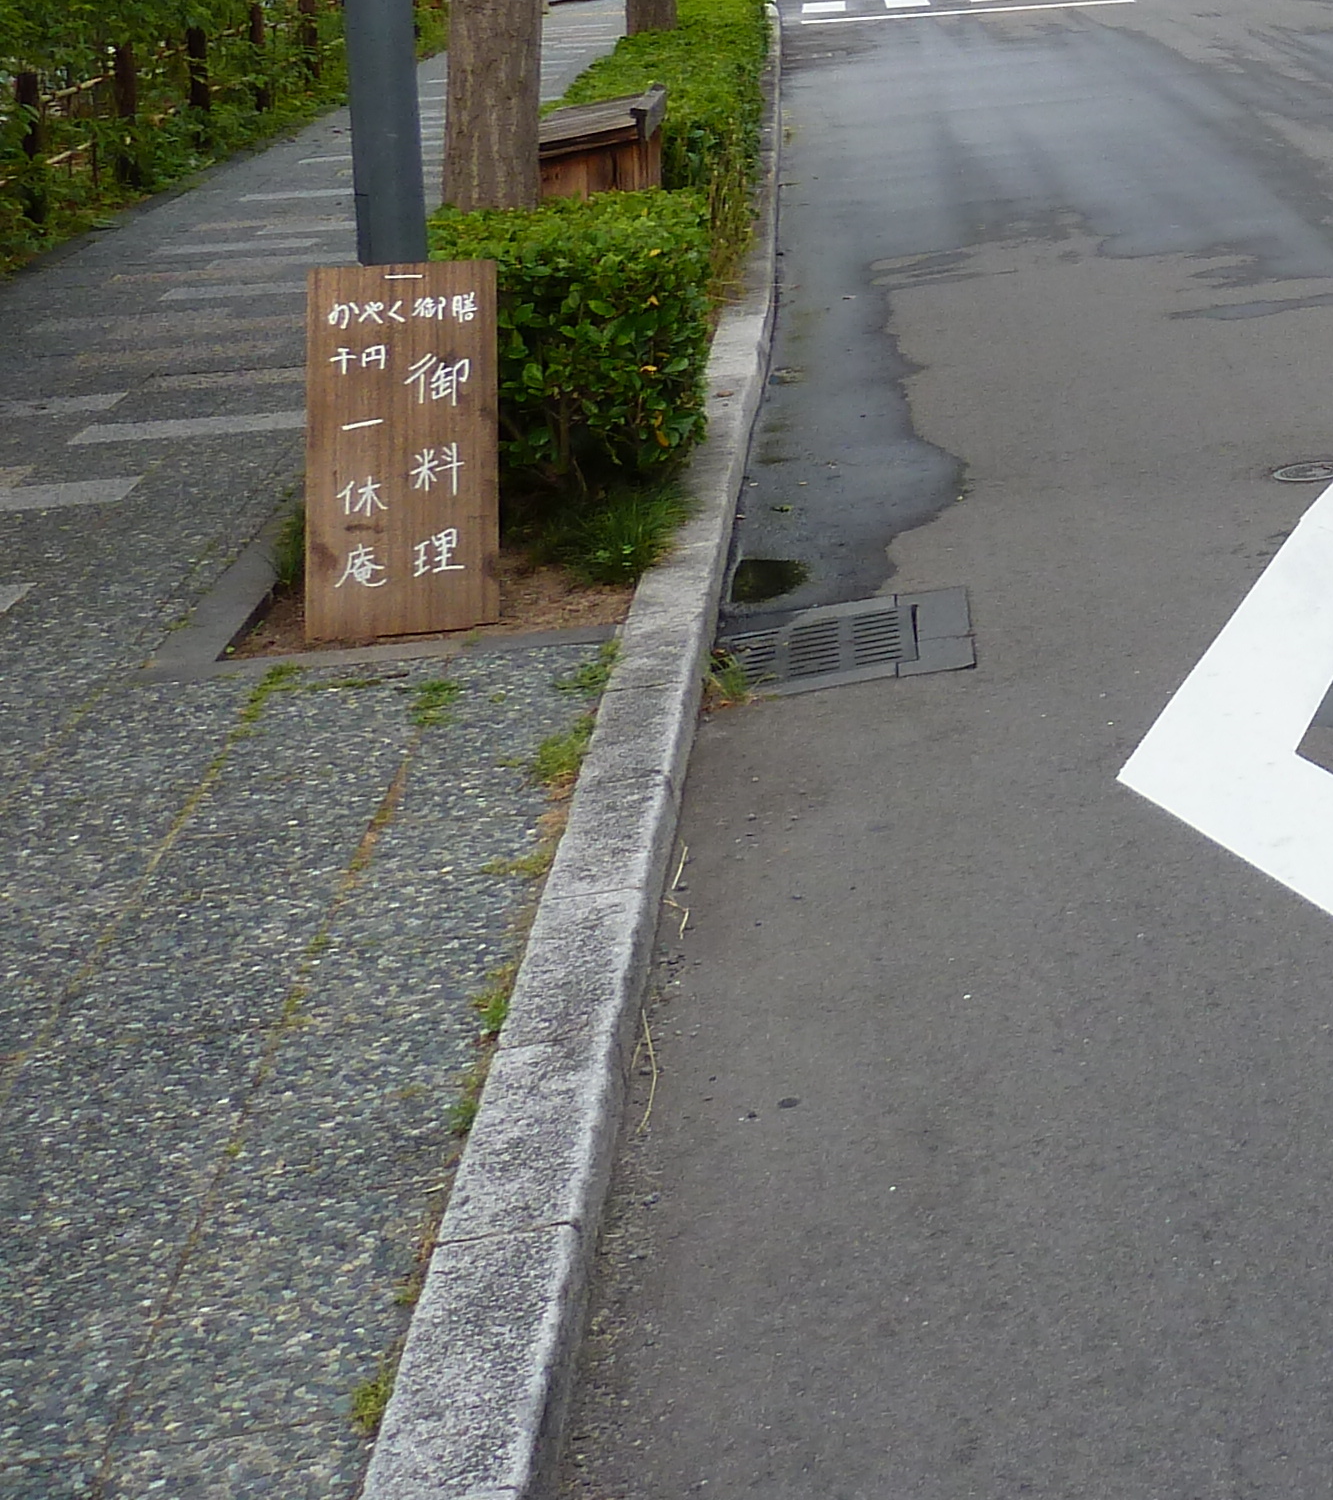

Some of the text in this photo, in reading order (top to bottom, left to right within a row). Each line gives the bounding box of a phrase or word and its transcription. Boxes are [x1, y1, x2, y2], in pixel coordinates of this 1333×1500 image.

[327, 292, 478, 329] かやく御膳
[335, 419, 388, 588] 一休庵
[404, 354, 470, 577] 御料理
